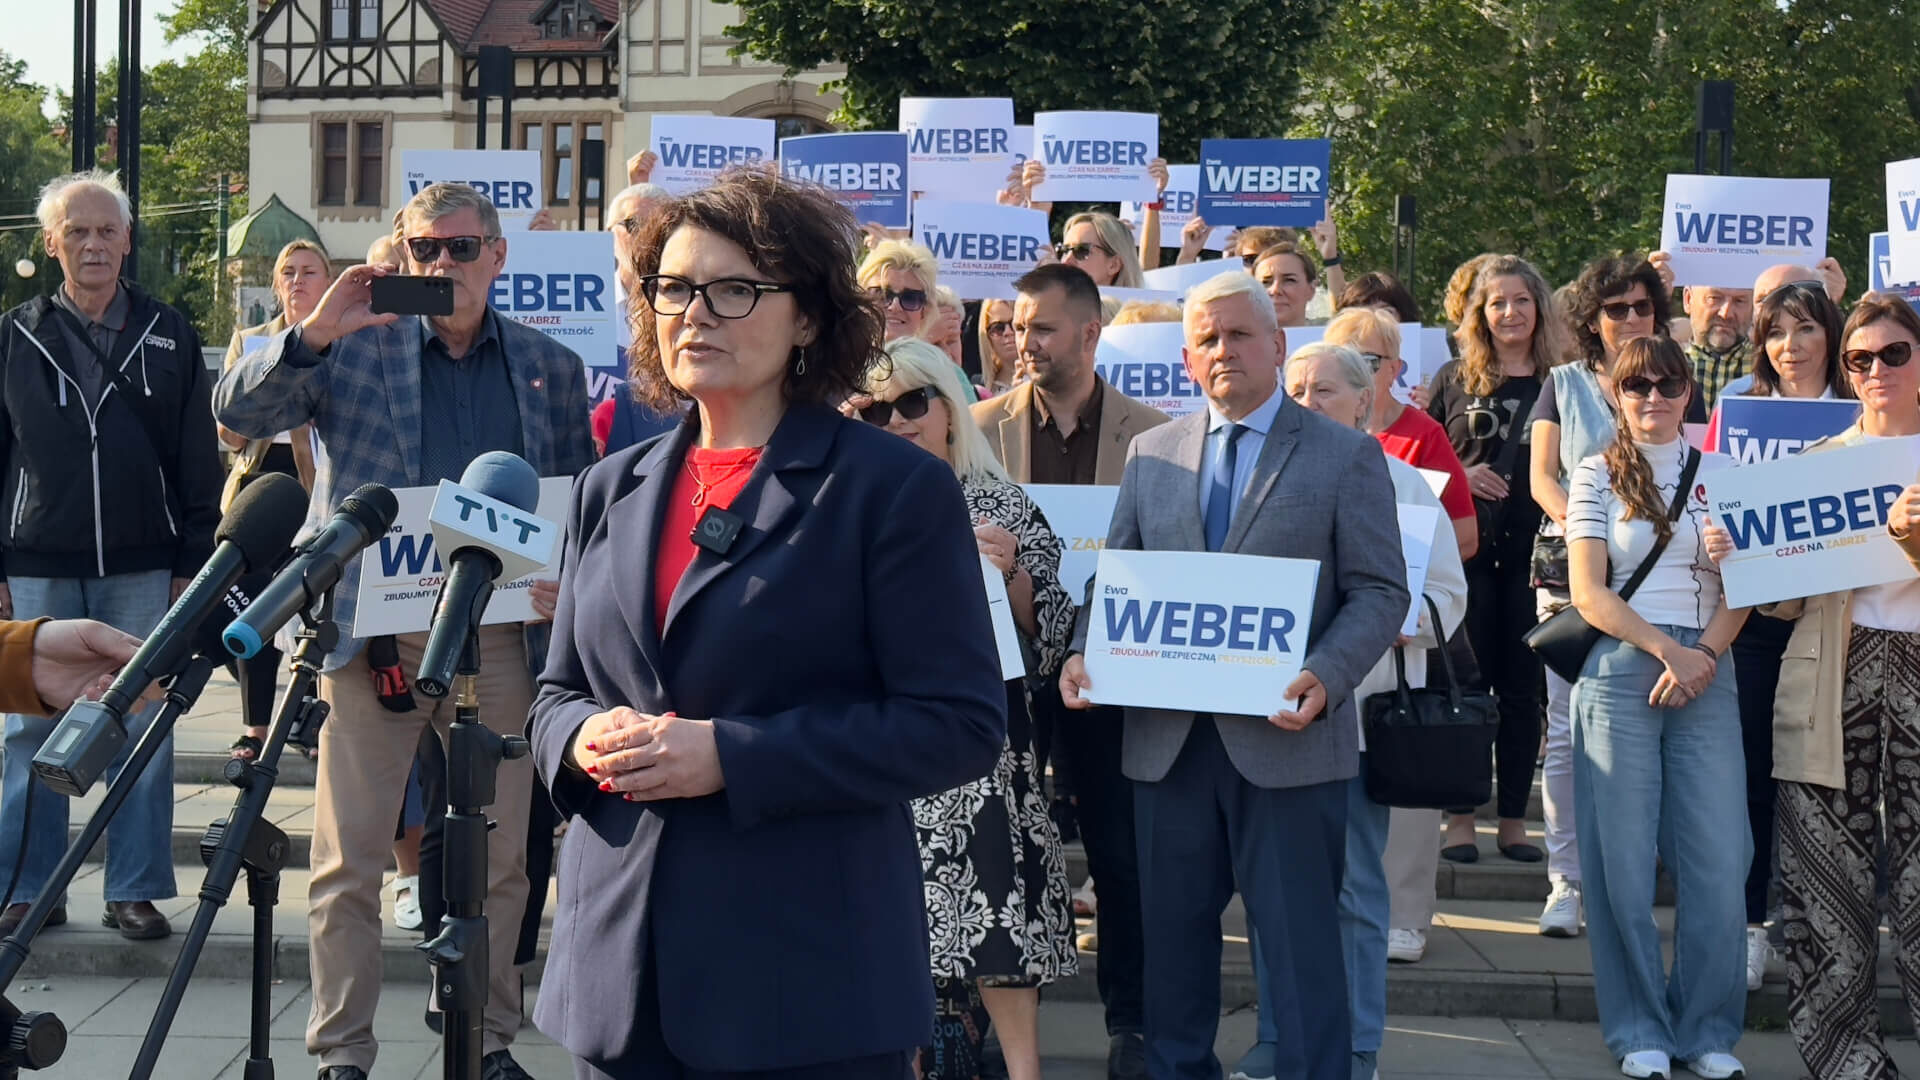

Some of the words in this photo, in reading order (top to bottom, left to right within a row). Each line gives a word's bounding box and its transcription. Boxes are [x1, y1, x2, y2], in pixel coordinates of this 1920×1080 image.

[907, 128, 1009, 154] WEBER
[1043, 140, 1148, 166] WEBER
[1205, 165, 1321, 193] WEBER
[1675, 211, 1815, 247] WEBER
[923, 231, 1040, 262] WEBER
[488, 273, 606, 312] EBER
[1728, 426, 1749, 436] Ewa
[1718, 500, 1742, 512] Ewa
[1775, 544, 1806, 558] CZAS
[1807, 541, 1825, 552] NA
[1826, 533, 1868, 549] ZABRZE
[230, 585, 250, 606] RAD
[1104, 584, 1129, 596] Ewa
[1103, 597, 1297, 654] WEBER
[1109, 647, 1160, 659] ZBUDUJMY
[1161, 649, 1217, 664] BEZPIECZNĄ
